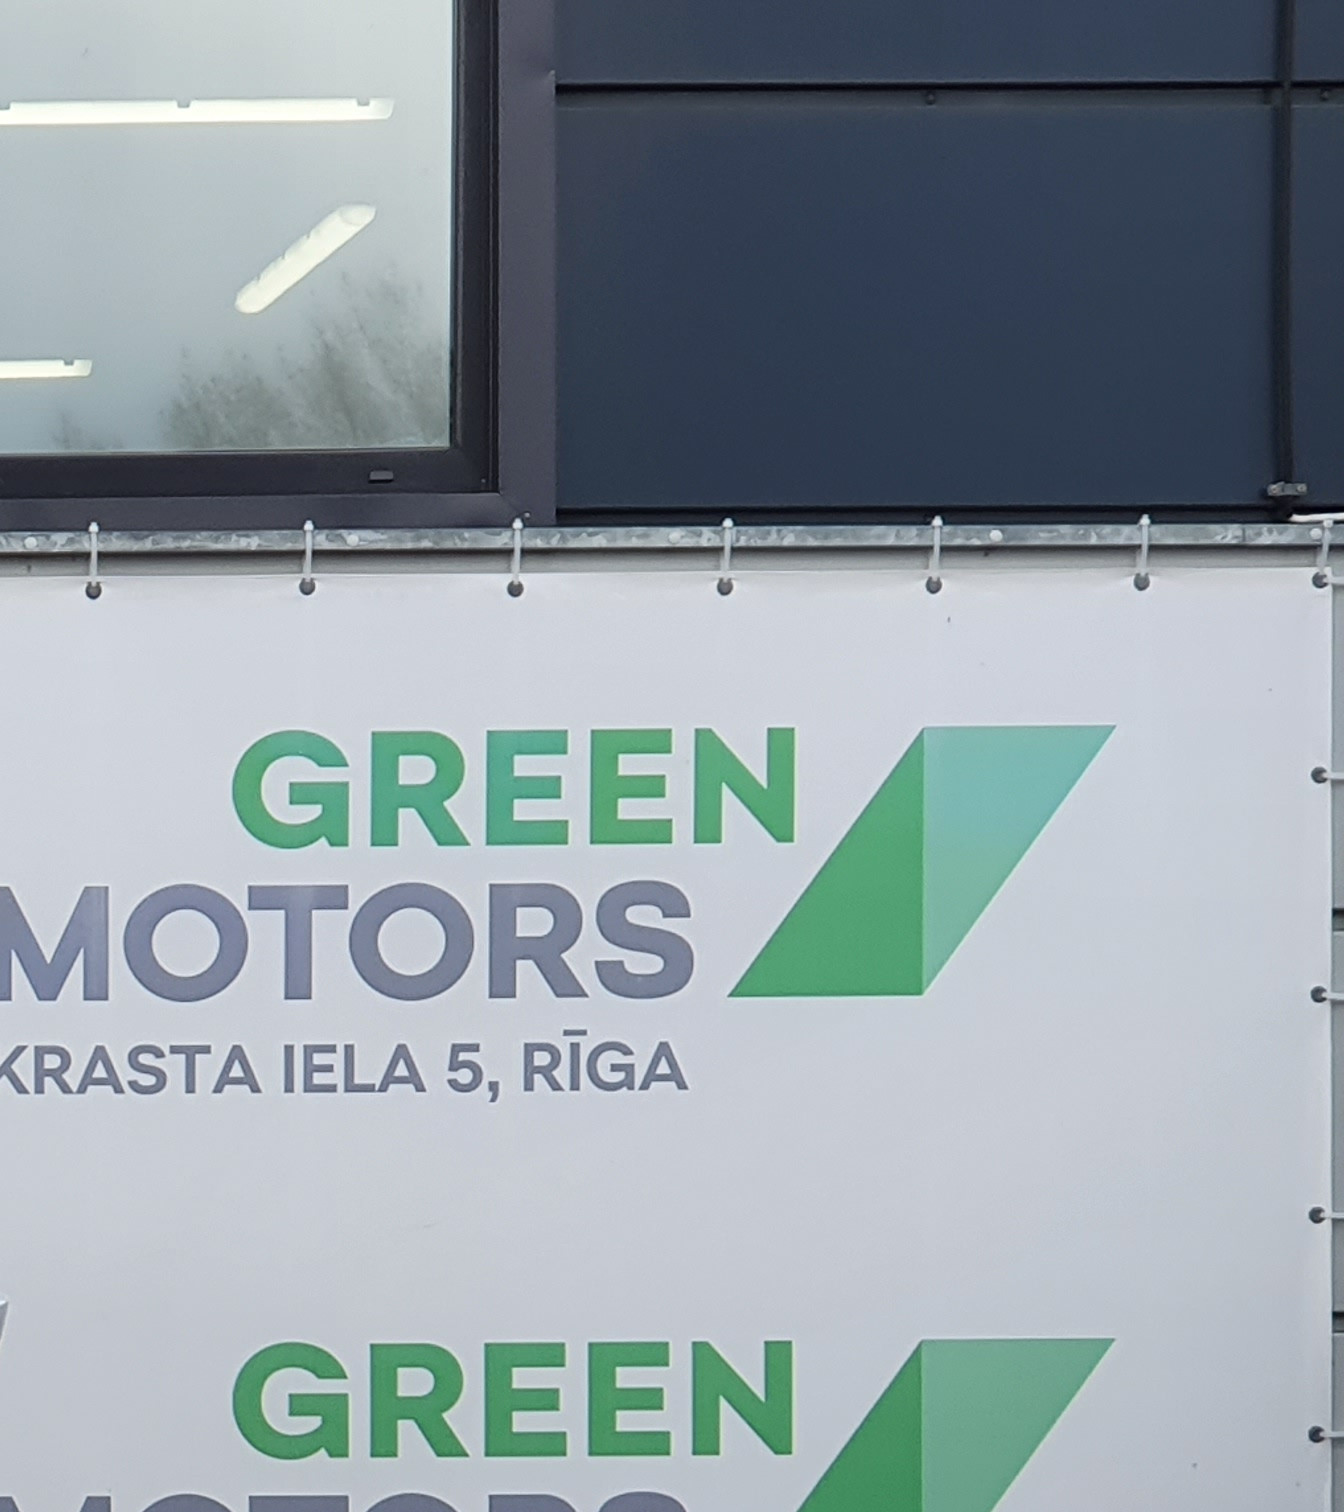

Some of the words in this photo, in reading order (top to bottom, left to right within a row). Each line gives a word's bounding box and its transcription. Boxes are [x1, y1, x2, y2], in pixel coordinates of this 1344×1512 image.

[232, 728, 795, 849] GREEN
[284, 1044, 426, 1093] IELA
[447, 1043, 499, 1102] 5,
[524, 1029, 688, 1092] RĪGA
[232, 1341, 793, 1460] GREEN
